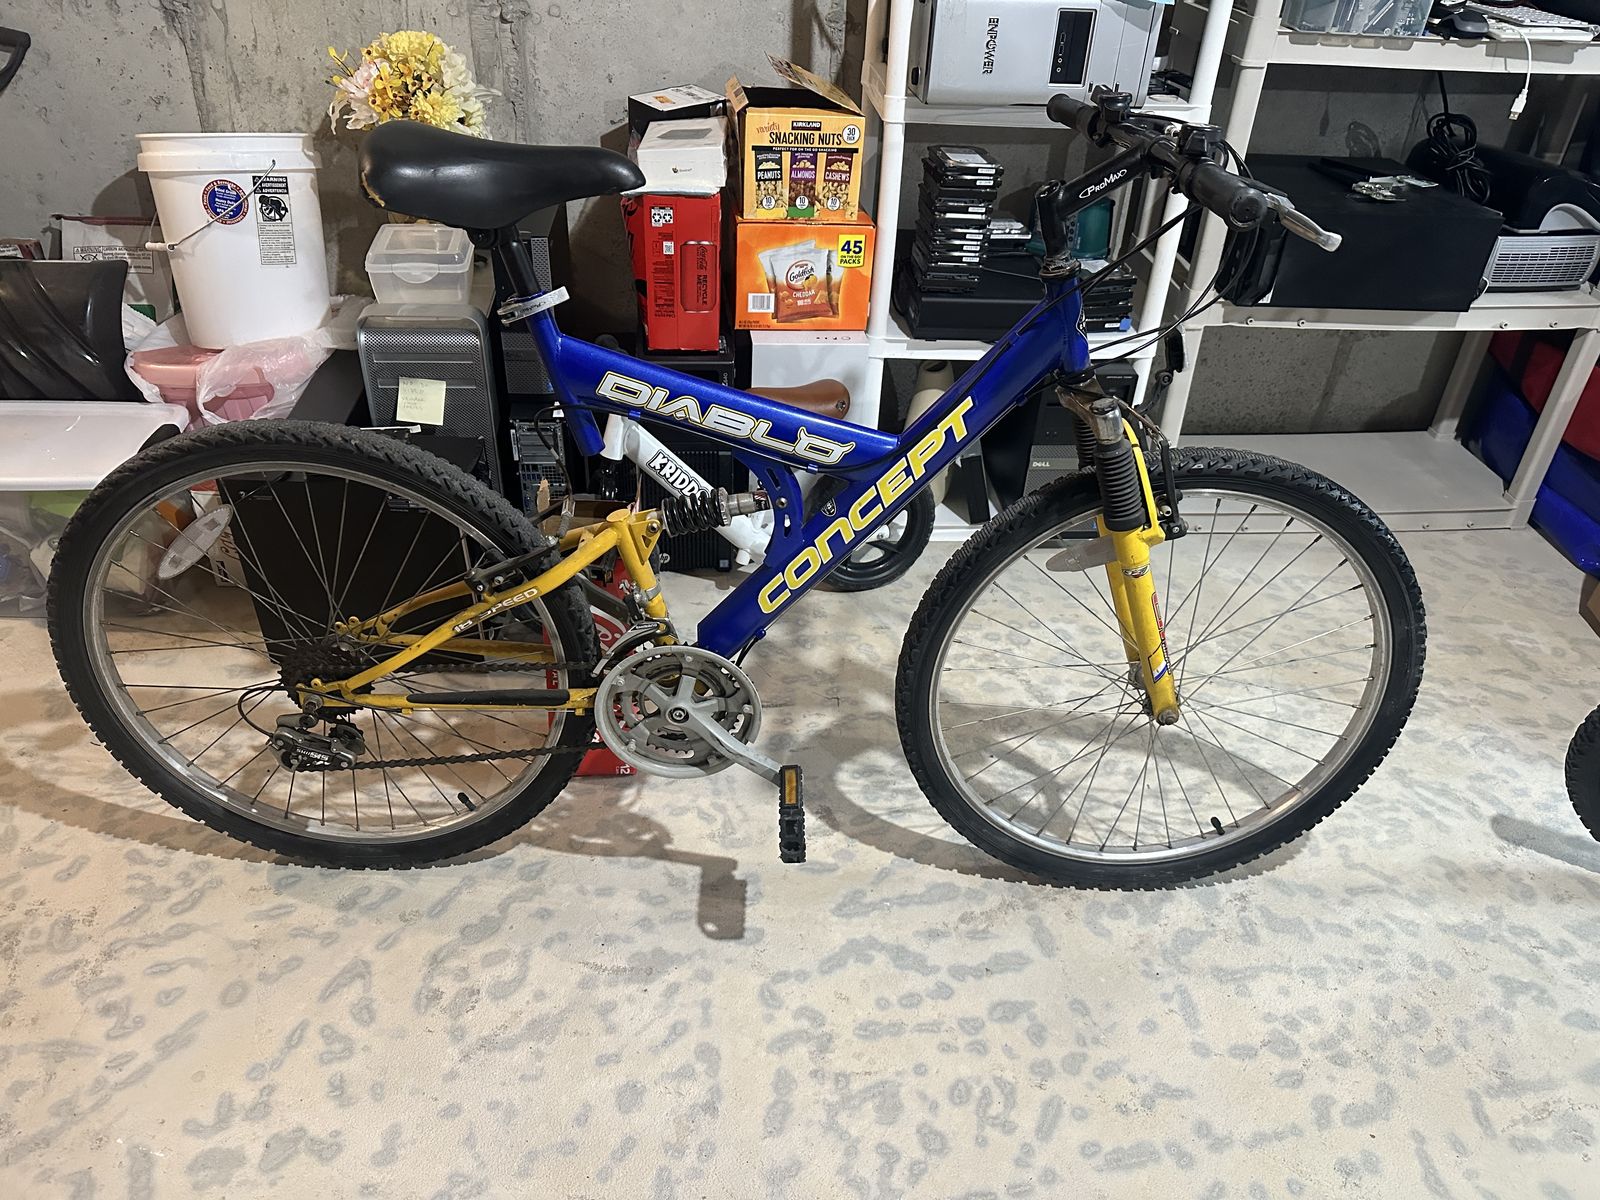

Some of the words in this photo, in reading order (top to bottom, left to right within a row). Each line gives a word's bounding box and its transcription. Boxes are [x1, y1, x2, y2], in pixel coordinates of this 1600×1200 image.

[982, 17, 999, 75] ENPOWER
[756, 121, 780, 134] variety
[793, 121, 820, 129] KIRKLAND
[847, 127, 856, 136] 30
[769, 132, 815, 145] SNACKING
[818, 133, 842, 146] NUTS
[757, 170, 781, 180] PEANUTS
[791, 170, 815, 179] ALMONDS
[825, 171, 849, 181] CASHEWS
[841, 240, 863, 255] 45
[789, 266, 816, 282] Goldfish
[597, 371, 855, 465] DIABLO
[757, 396, 974, 614] CONCEPT
[620, 763, 631, 775] 12
